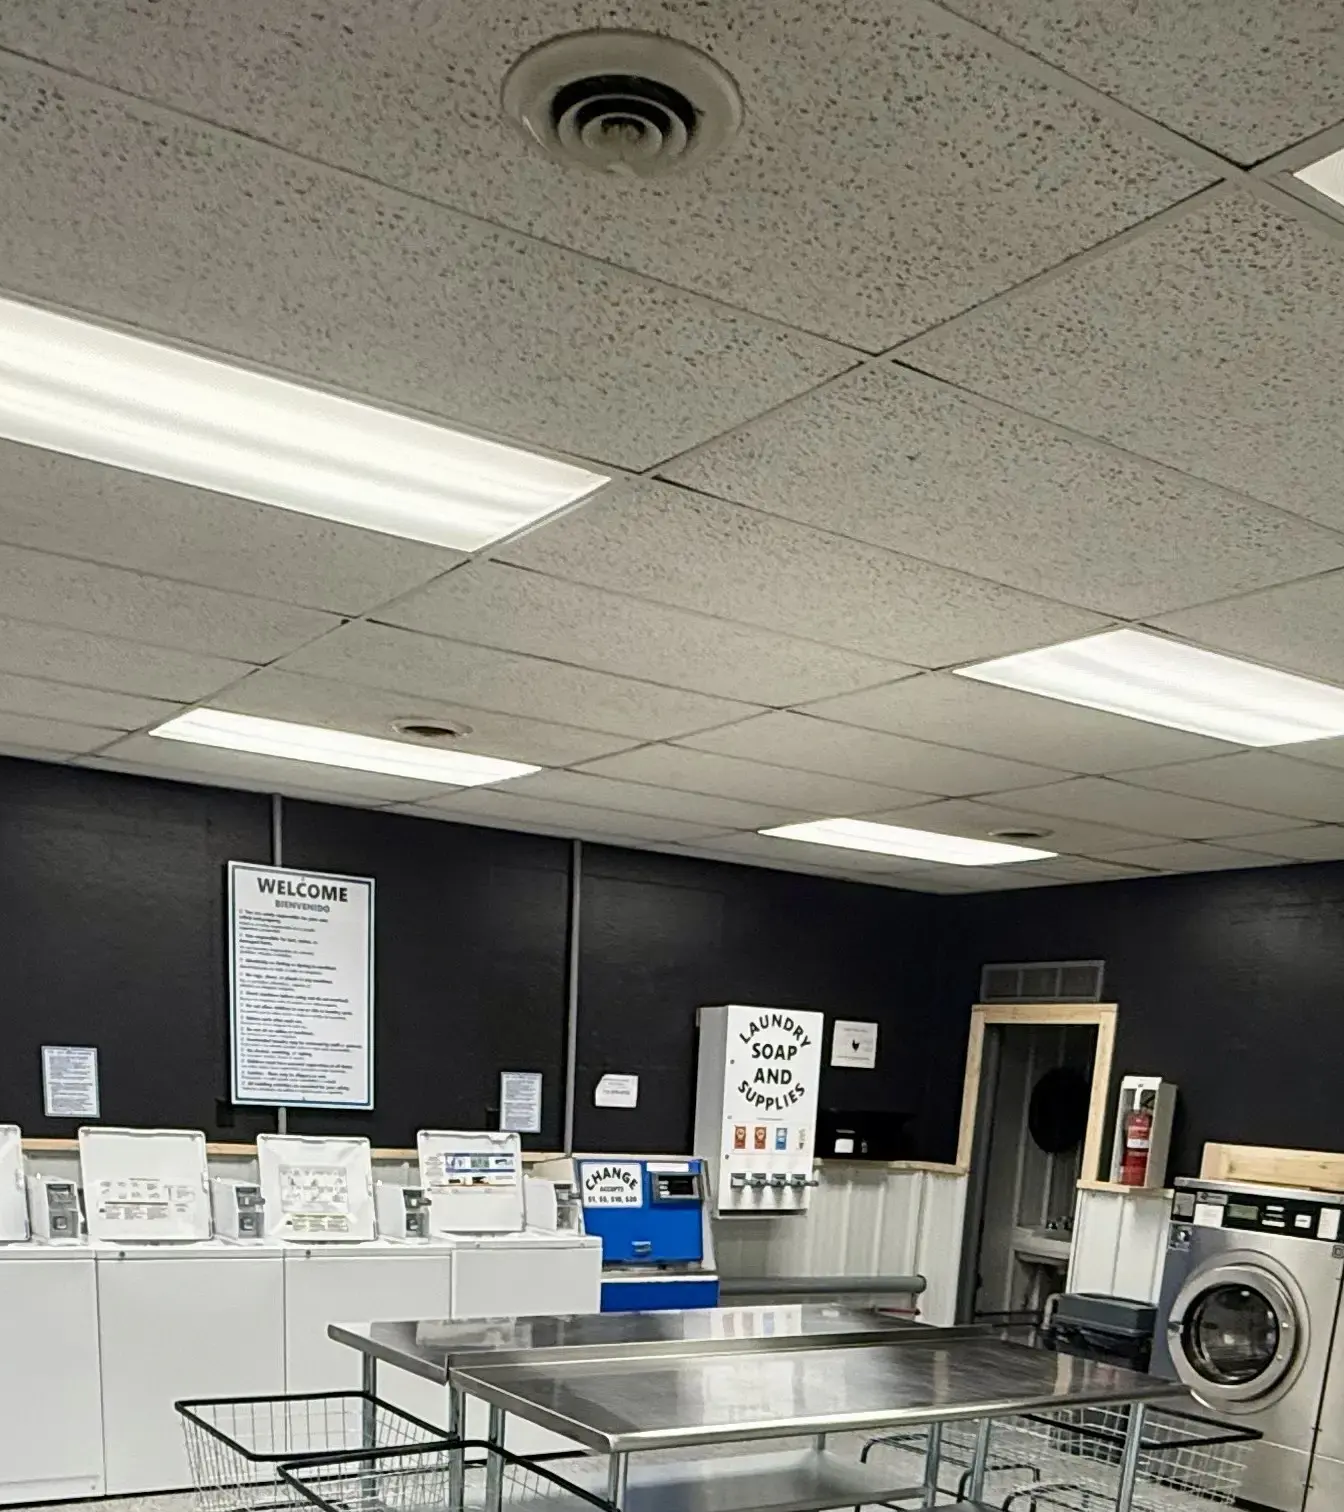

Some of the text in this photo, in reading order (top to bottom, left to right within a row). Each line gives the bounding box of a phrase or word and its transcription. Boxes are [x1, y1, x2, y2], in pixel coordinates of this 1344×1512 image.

[257, 877, 348, 902] WELCOME
[275, 899, 330, 913] BIENVENIDO
[739, 1014, 812, 1049] LAUNDRY
[751, 1042, 797, 1060] SOAP
[753, 1067, 792, 1085] AND
[738, 1080, 805, 1111] SUPPLIES
[585, 1167, 638, 1191] CHANGE
